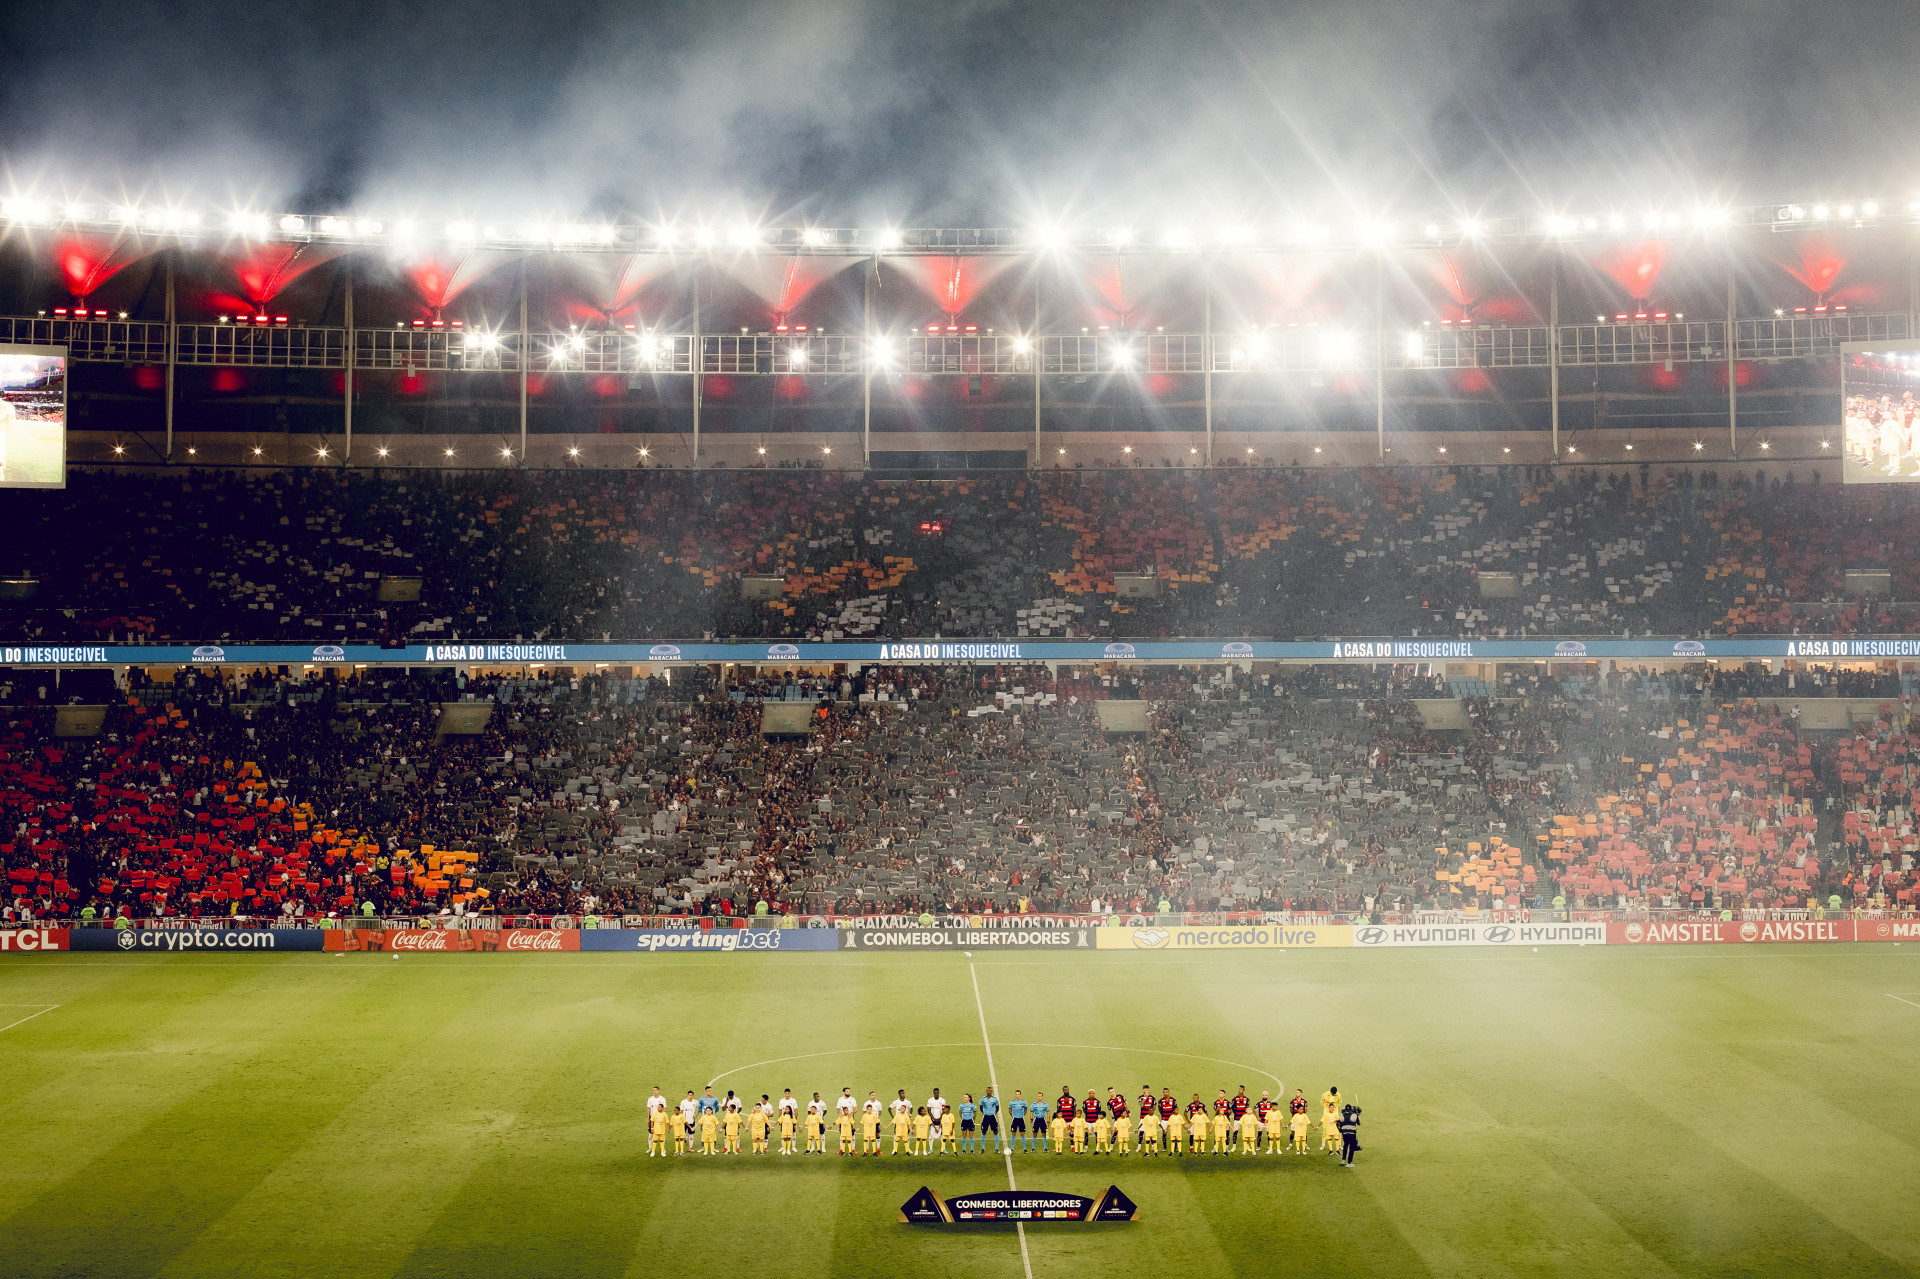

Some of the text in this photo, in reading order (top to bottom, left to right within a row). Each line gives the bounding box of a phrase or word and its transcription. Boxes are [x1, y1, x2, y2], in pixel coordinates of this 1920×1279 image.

[5, 648, 22, 663] DO
[24, 646, 108, 663] INESQUECÍVEL
[425, 644, 567, 661] A CASA DO INESQUECÍVEL
[880, 642, 1022, 660] A CASA DO INESQUECÍVEL
[1333, 641, 1473, 658] A CASA DO INESQUECÍVEL
[1787, 641, 1796, 656] A
[1798, 641, 1829, 656] CASA
[1832, 641, 1848, 656] DO
[33, 919, 59, 929] FLA
[1645, 923, 1724, 941] AMSTEL
[1761, 922, 1839, 940] AMSTEL
[0, 930, 59, 950] TCL
[140, 929, 275, 950] crypto.com
[507, 931, 564, 950] Coca-Cola
[637, 929, 781, 951] sportingbet
[863, 931, 1071, 946] CONMEBOL LIBERTADORES
[1176, 927, 1317, 945] mercado livre
[1393, 929, 1476, 941] HYUNDAI
[1520, 927, 1602, 940] HYUNDAI
[956, 1199, 1082, 1209] CONMEBOL LIBERTADORES
